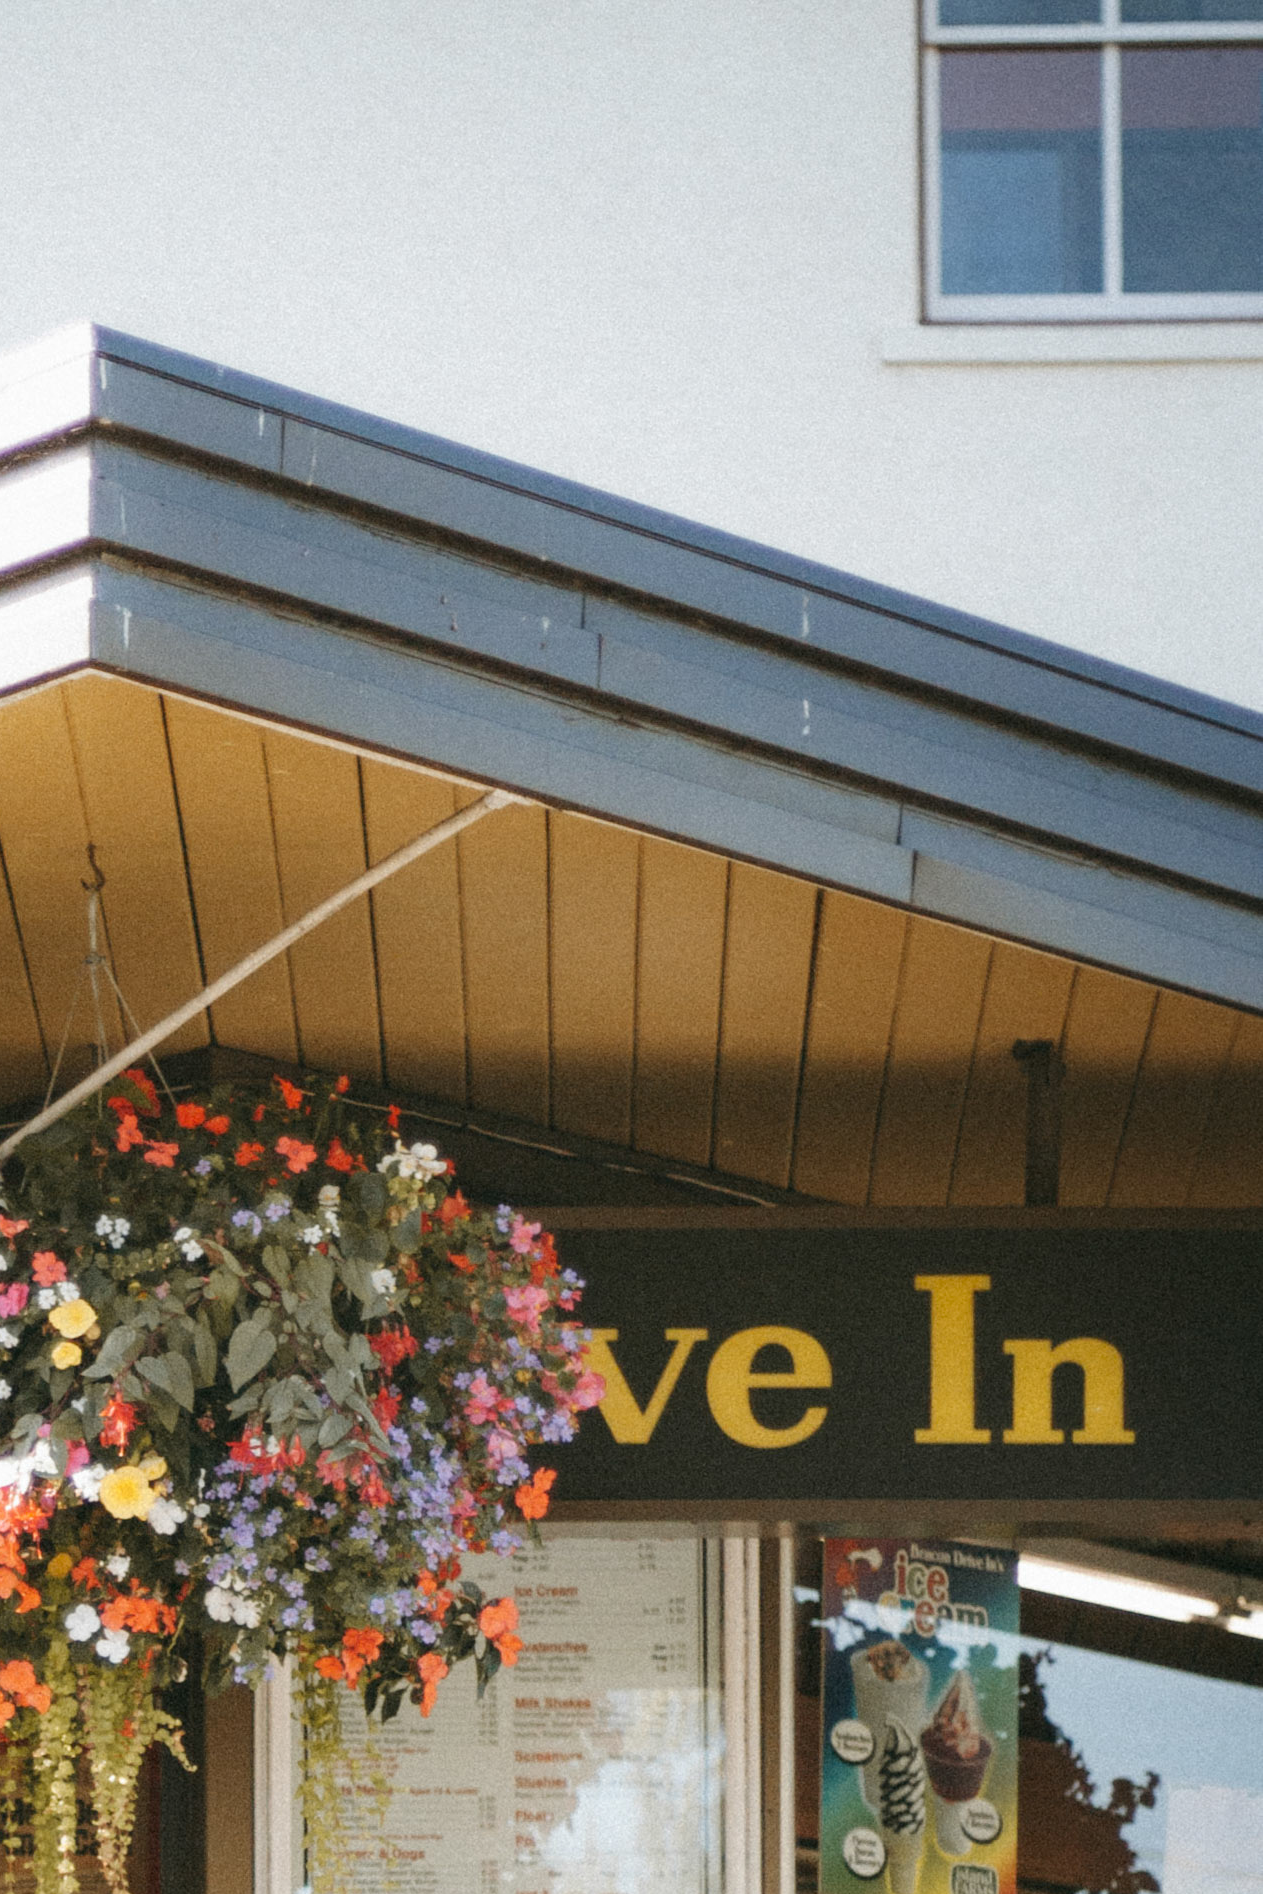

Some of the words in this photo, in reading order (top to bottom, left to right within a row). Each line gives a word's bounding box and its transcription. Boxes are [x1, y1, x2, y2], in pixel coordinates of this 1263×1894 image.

[588, 1324, 833, 1449] ve
[913, 1274, 1135, 1445] In
[894, 1549, 950, 1603] ice
[519, 1642, 588, 1653] valanches
